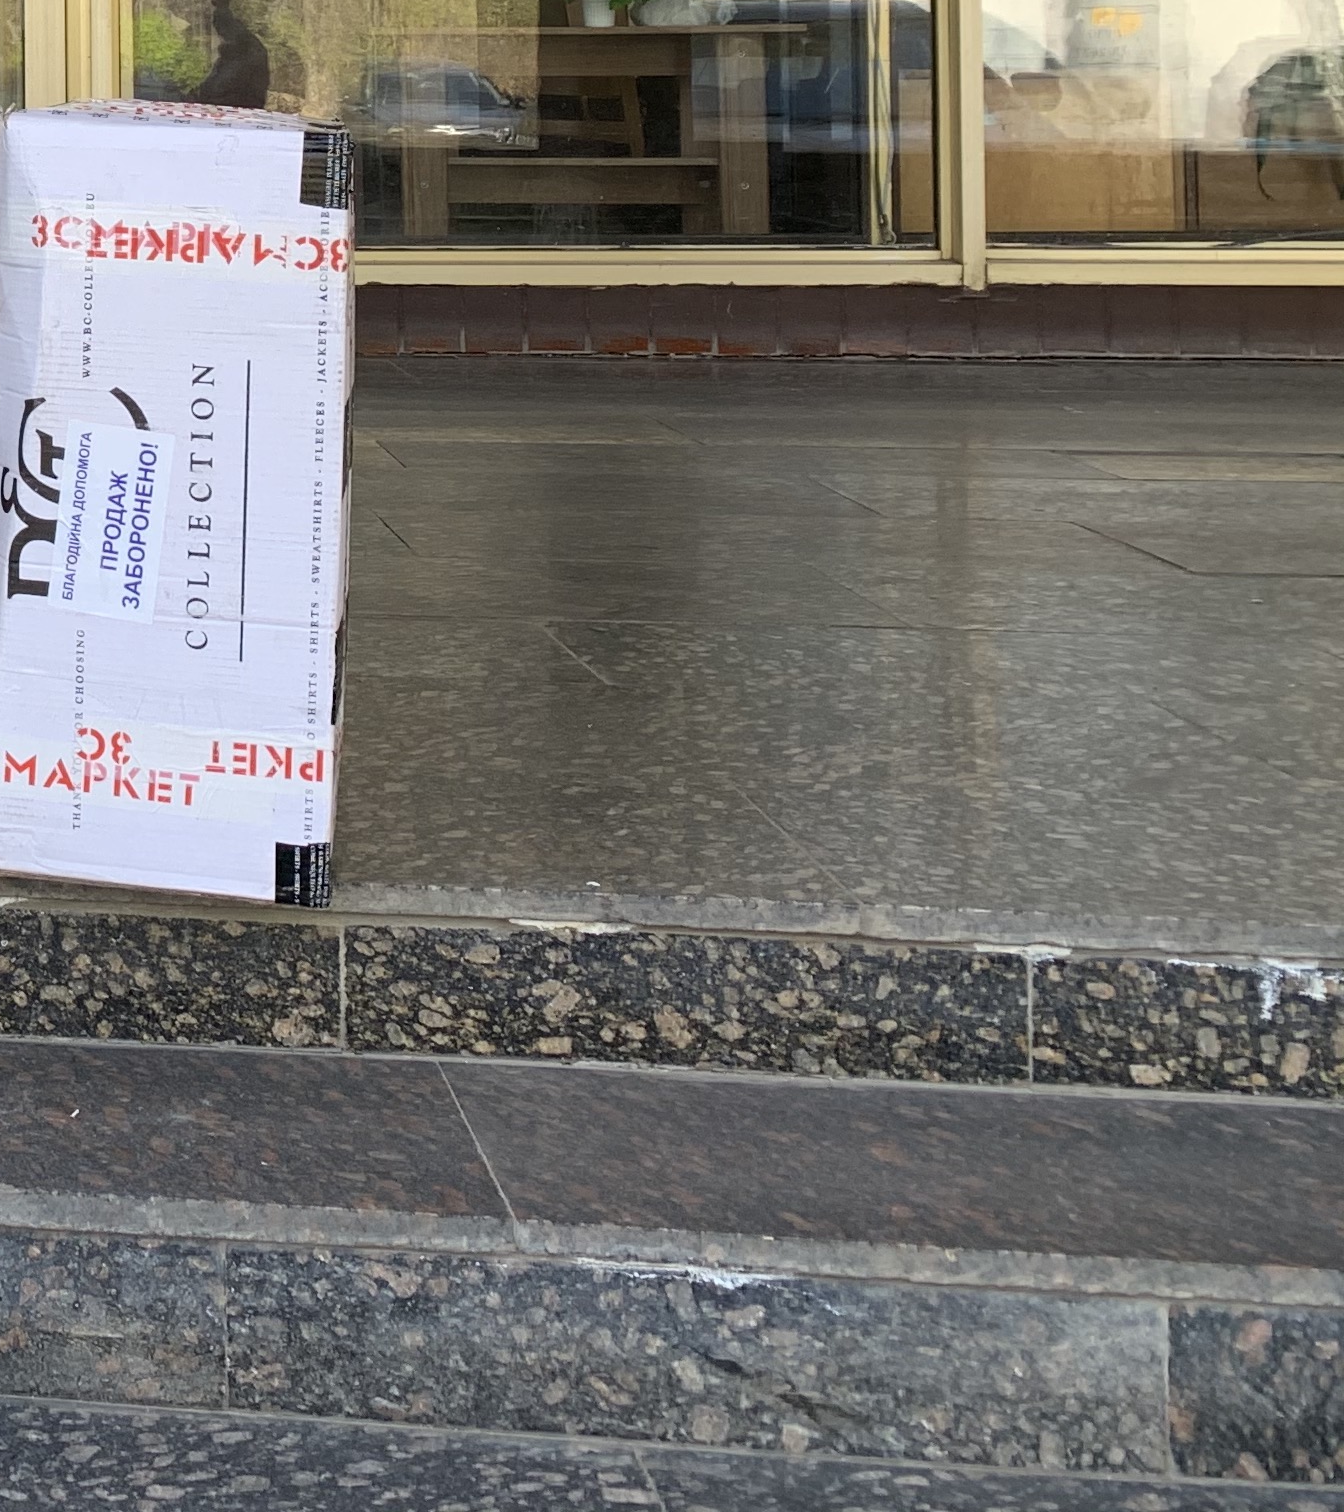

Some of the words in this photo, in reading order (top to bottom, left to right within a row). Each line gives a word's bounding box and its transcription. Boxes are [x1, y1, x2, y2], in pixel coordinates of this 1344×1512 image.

[319, 210, 331, 303] ACCESSORIE
[316, 320, 328, 384] JACKETS
[314, 400, 326, 462] FLEECES
[62, 512, 83, 601] БЛАГОДІЙНА
[73, 431, 93, 511] ДОПОМОГА
[99, 470, 129, 571] ПРОДАЖ
[121, 441, 159, 610] ЗАБОРОНЕНО!
[184, 363, 215, 650] COLLECTION
[311, 480, 323, 584] SWEATSHIRTS
[75, 629, 86, 705] CHOOSING
[309, 601, 320, 654] SHIRTS
[308, 672, 319, 724] SHIRTS
